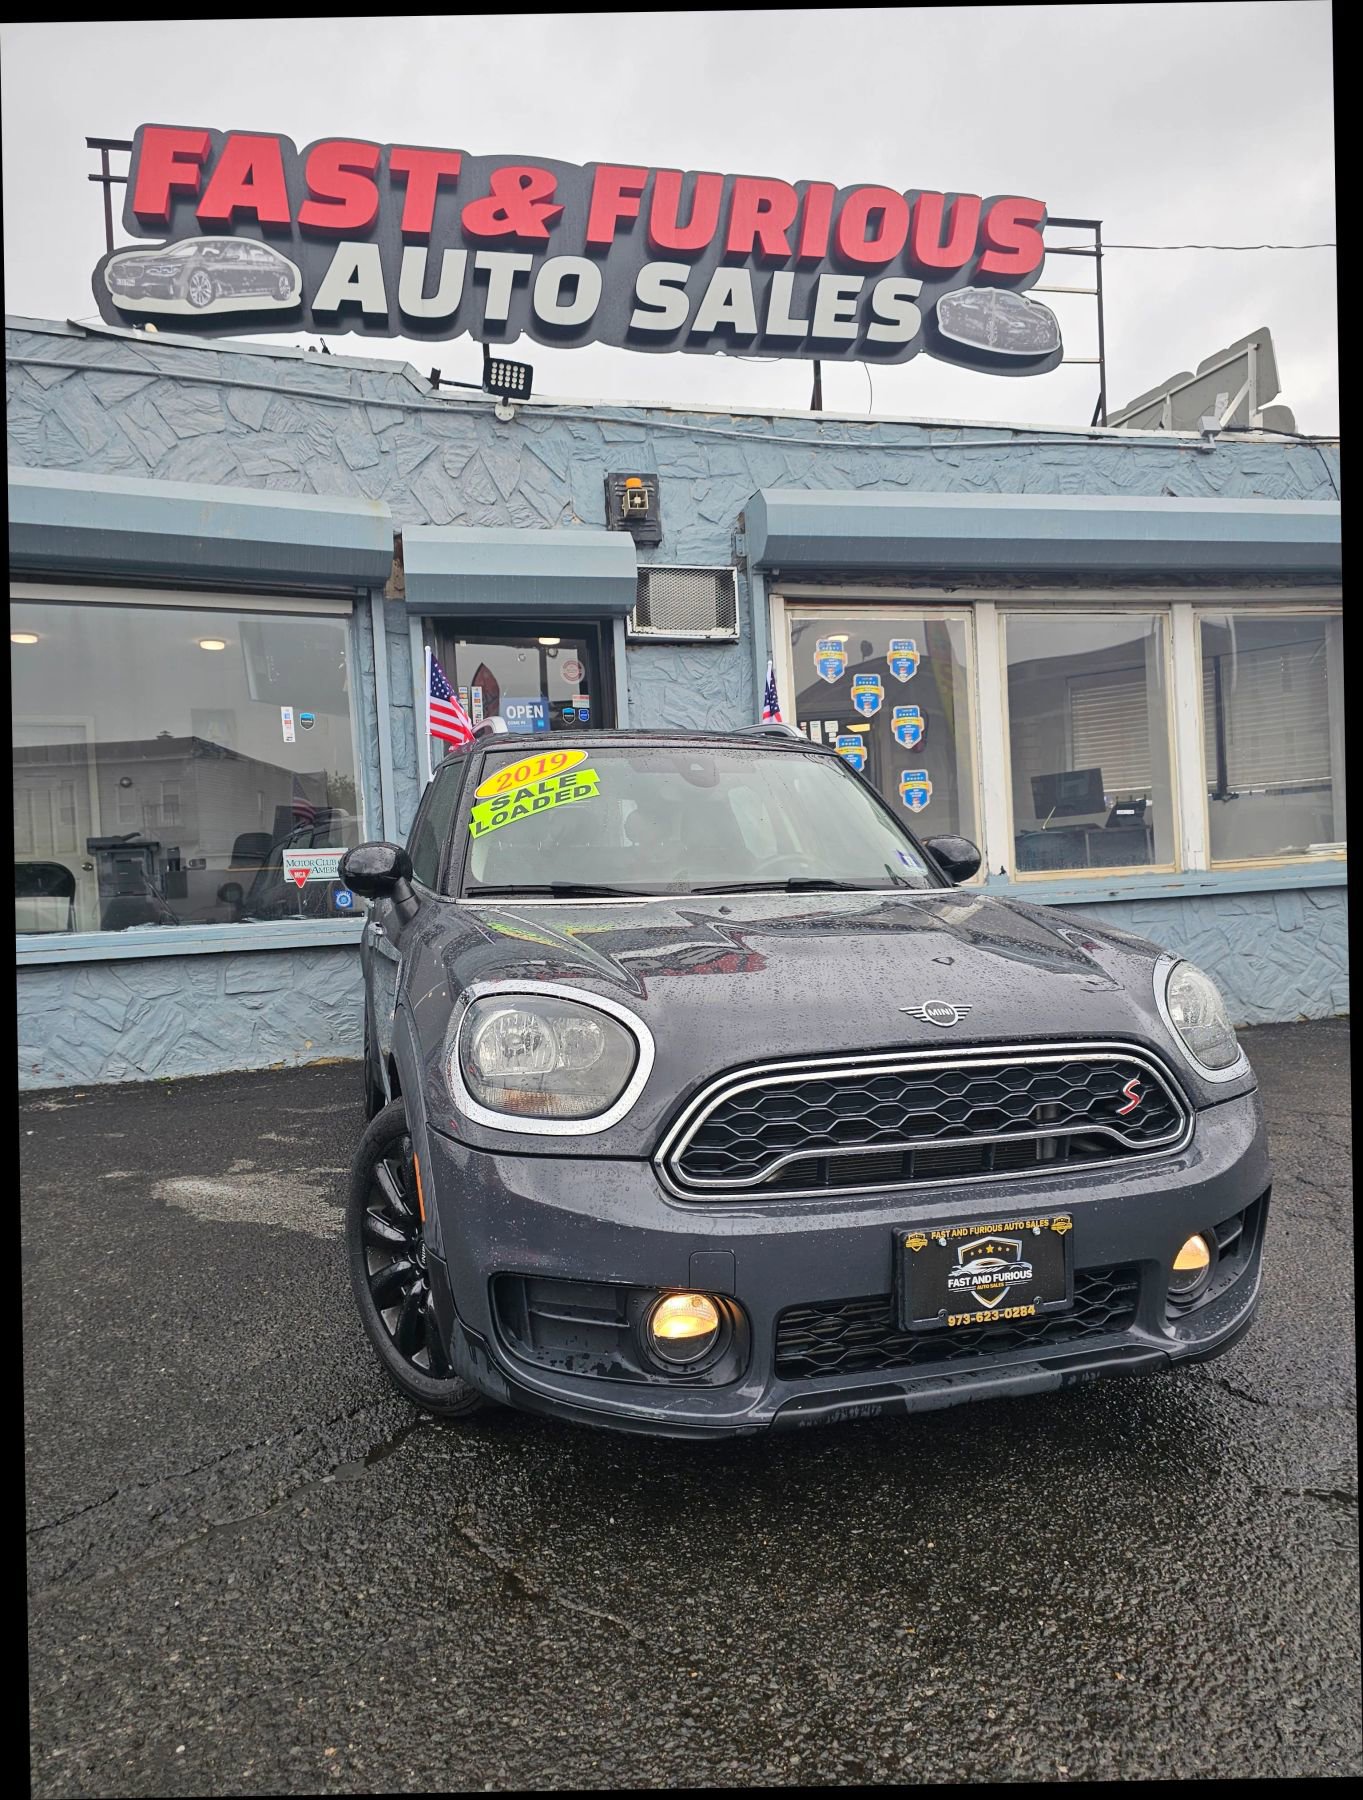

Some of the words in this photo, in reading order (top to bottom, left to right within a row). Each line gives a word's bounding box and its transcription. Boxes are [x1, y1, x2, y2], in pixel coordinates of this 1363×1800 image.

[133, 126, 462, 238] FAST
[461, 165, 564, 242] &
[586, 165, 1047, 277] FURIOUS
[311, 241, 602, 327] AUTO
[629, 261, 923, 344] SALES
[506, 705, 544, 719] OPEN
[496, 753, 568, 792] 2019
[490, 773, 577, 811] SALE
[475, 784, 592, 835] LOADED
[286, 859, 315, 868] MOTOR
[315, 858, 337, 866] CLUB
[927, 1008, 953, 1016] MINI
[1115, 1079, 1140, 1115] S
[931, 1230, 950, 1239] FAST
[951, 1228, 968, 1237] AND
[969, 1224, 1003, 1235] FURIOUS
[1004, 1221, 1024, 1231] AUTO
[1025, 1219, 1049, 1229] SALES
[948, 1277, 971, 1288] FAST
[971, 1275, 992, 1284] AND
[992, 1269, 1033, 1282] FURIOUS
[948, 1305, 1035, 1326] 973-623-0284
